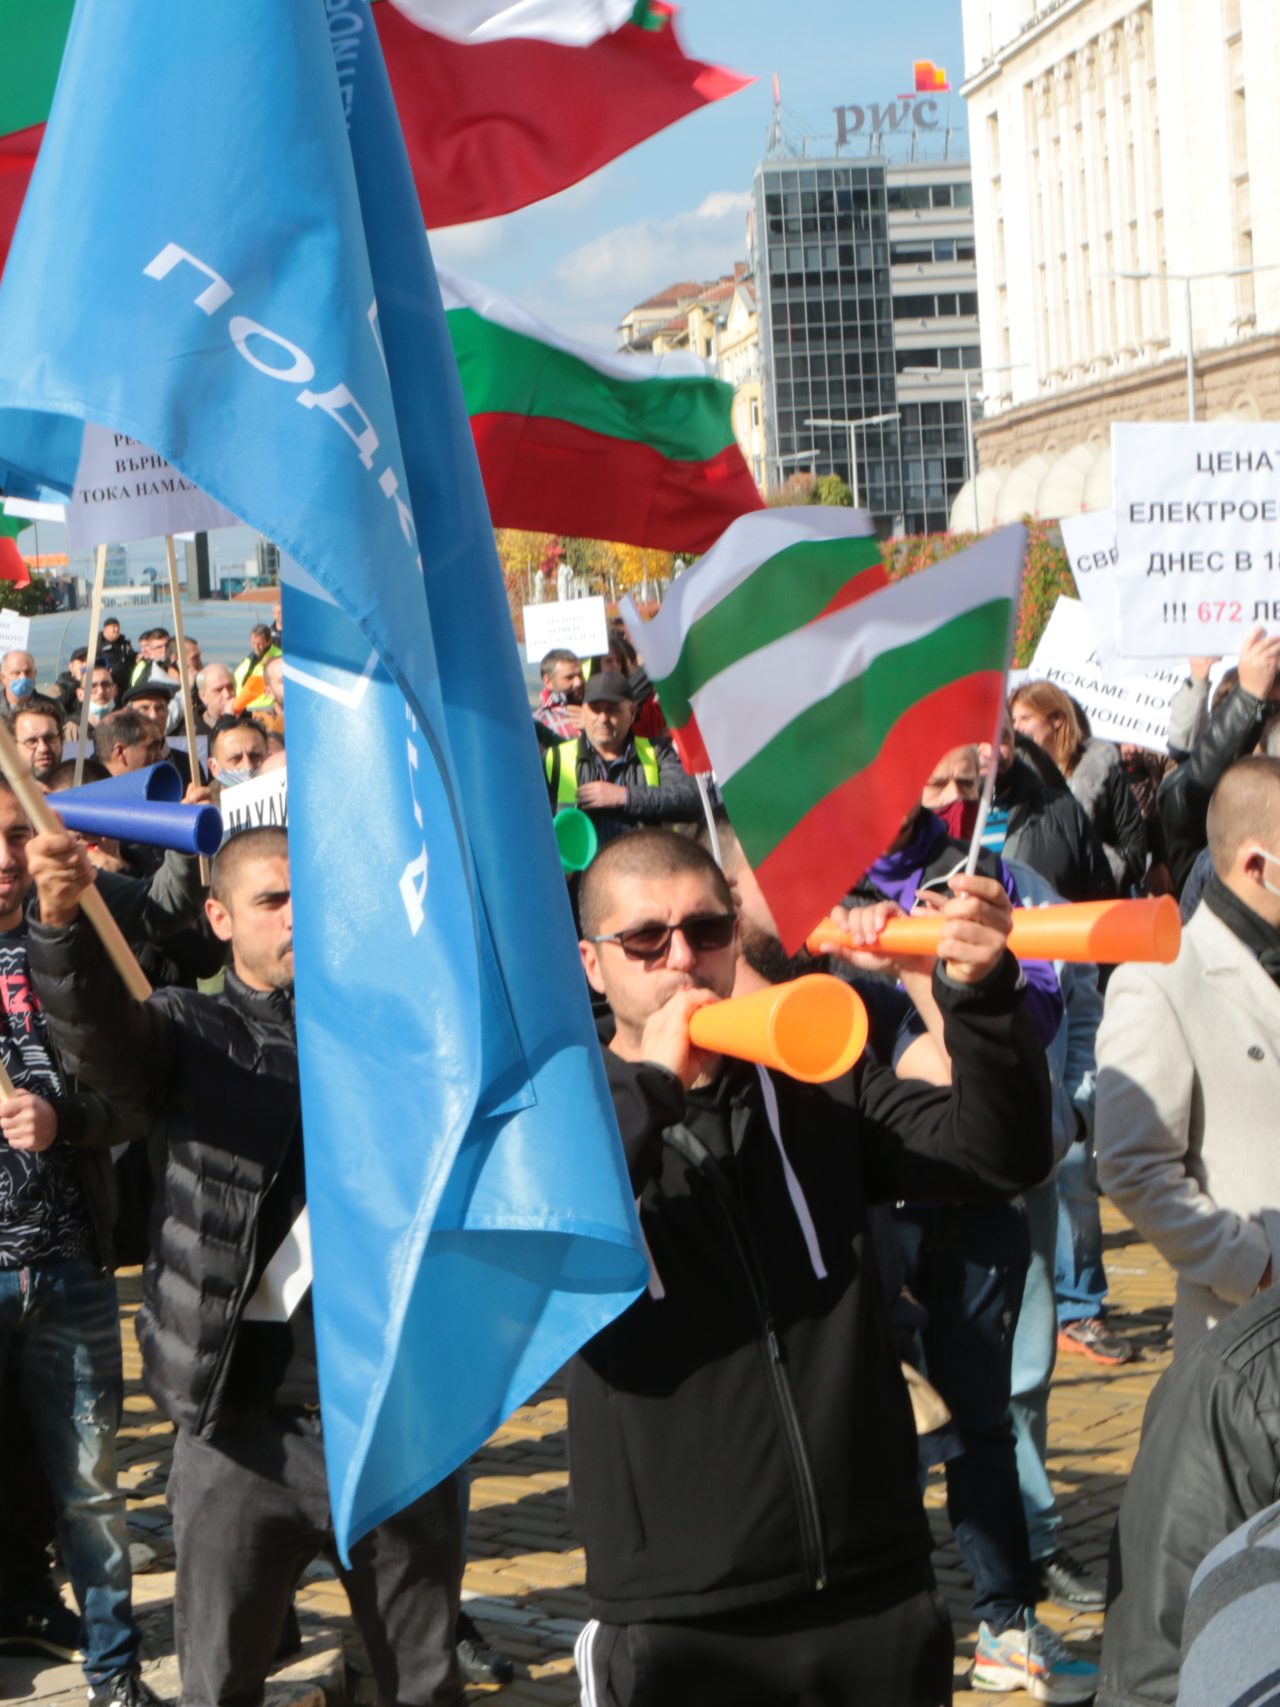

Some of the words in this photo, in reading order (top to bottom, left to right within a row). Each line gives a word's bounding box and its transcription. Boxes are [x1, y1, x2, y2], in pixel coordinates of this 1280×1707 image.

[832, 99, 939, 147] pwc
[115, 454, 168, 474] ВЪРН
[1195, 450, 1280, 477] ЦЕНА
[80, 485, 131, 505] ТОКА
[1128, 501, 1280, 524] ЕЛЕКТРОЕ
[1146, 551, 1225, 577] ДНЕС
[1234, 552, 1254, 571] В
[1262, 551, 1280, 571] 1
[1197, 601, 1243, 624] 672
[1252, 601, 1280, 622] ЛЕ
[1046, 667, 1131, 700] ИСКАМЕ
[1135, 691, 1172, 711] ПО
[1083, 703, 1169, 739] НОШЕНИ
